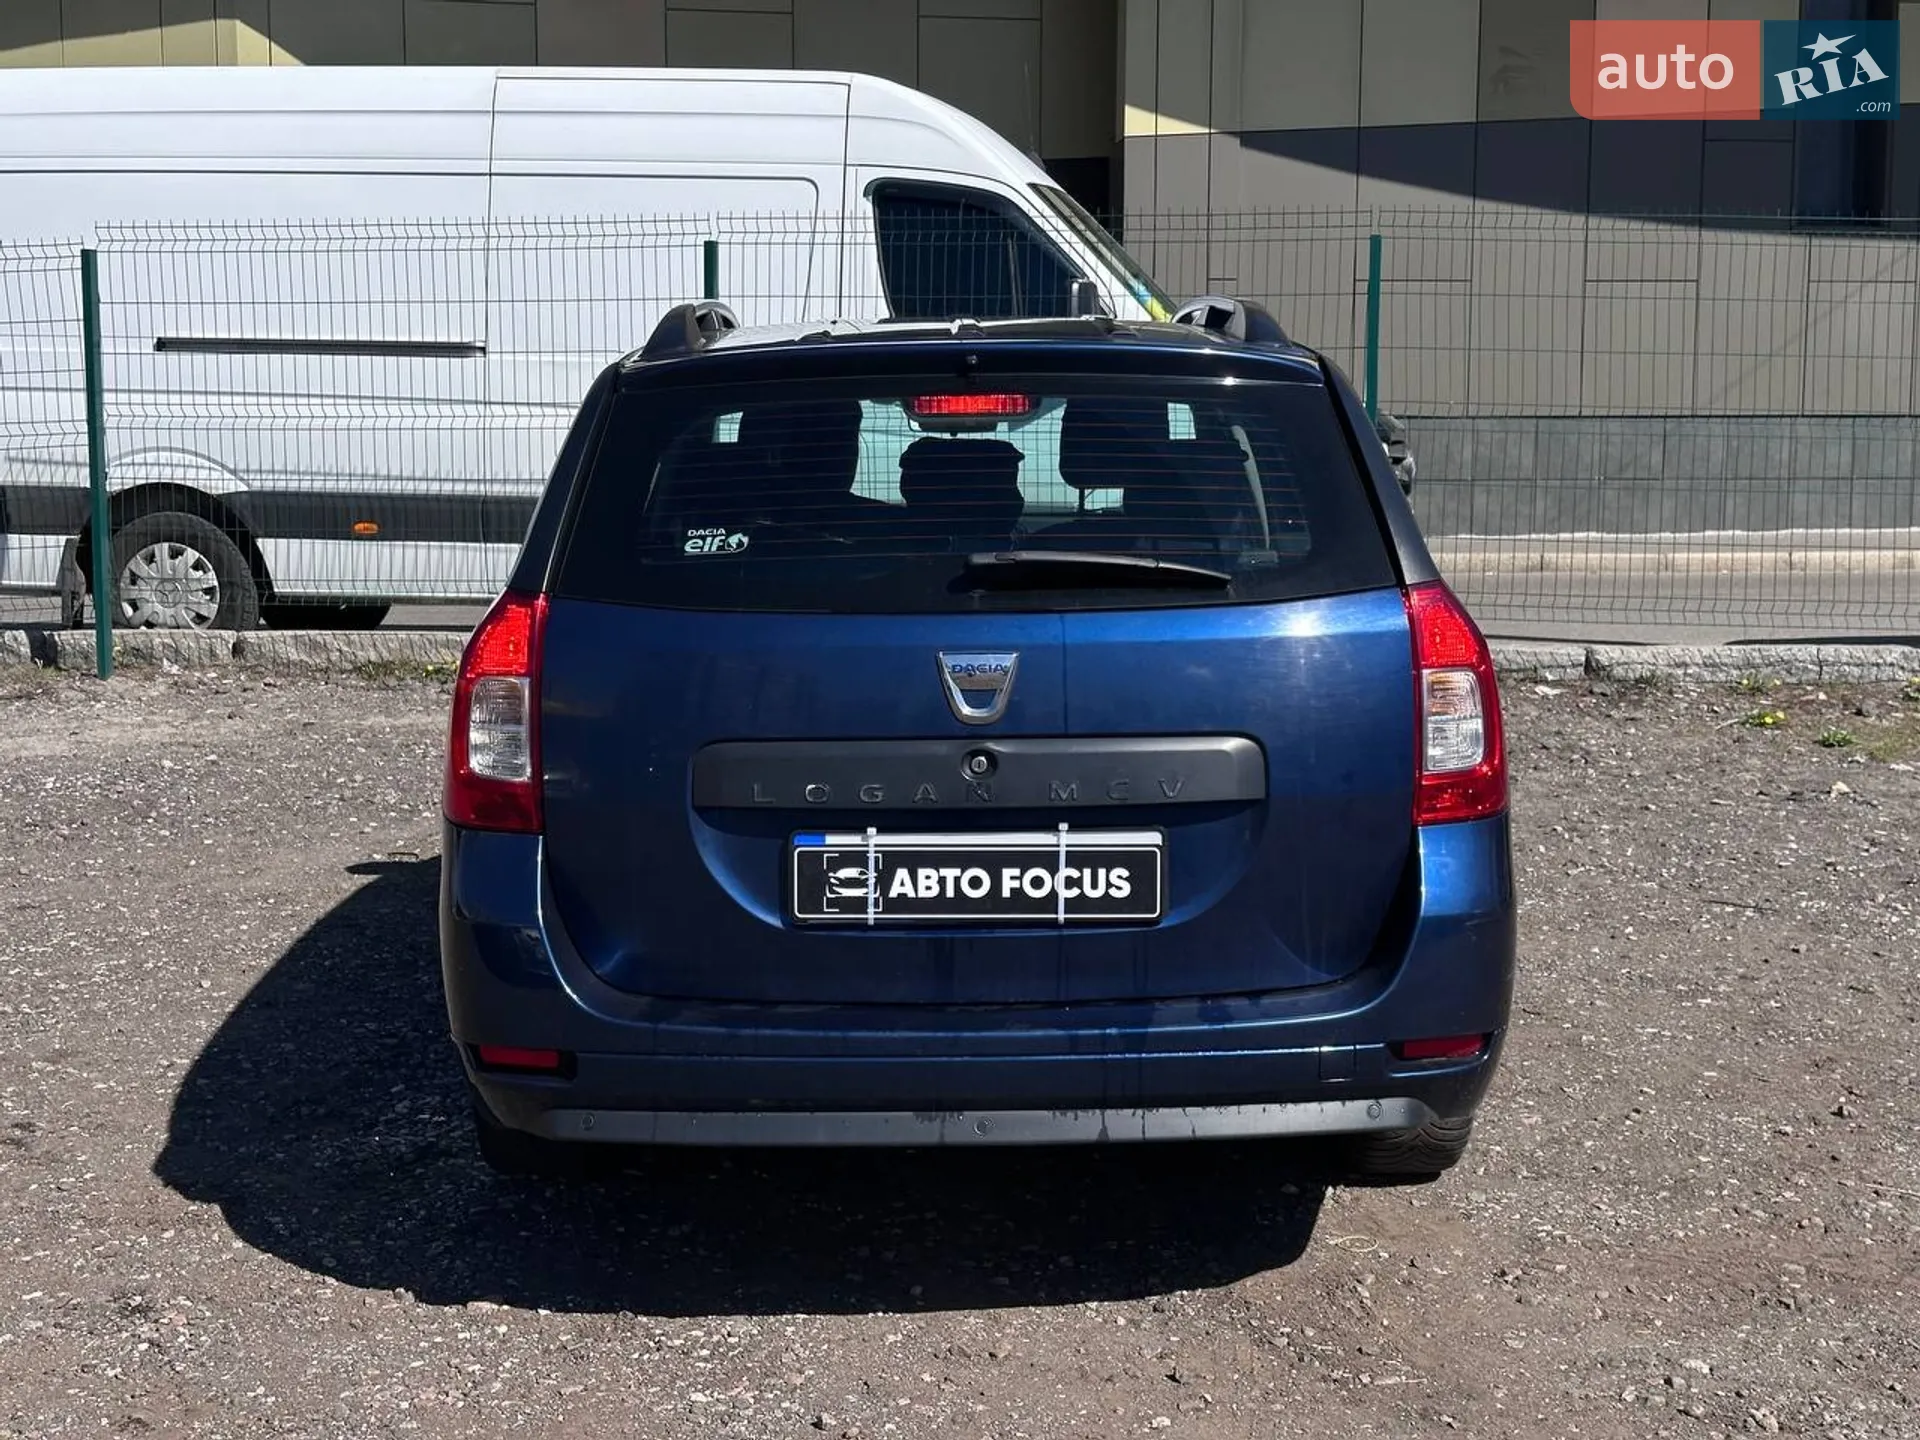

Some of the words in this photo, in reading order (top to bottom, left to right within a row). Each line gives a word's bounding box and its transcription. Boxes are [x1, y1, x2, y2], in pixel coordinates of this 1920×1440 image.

[687, 527, 726, 537] DACIA
[950, 663, 1006, 675] DACIA
[750, 781, 993, 804] LOGAN
[1048, 778, 1186, 802] MCV
[1002, 867, 1132, 899] FOCUS
